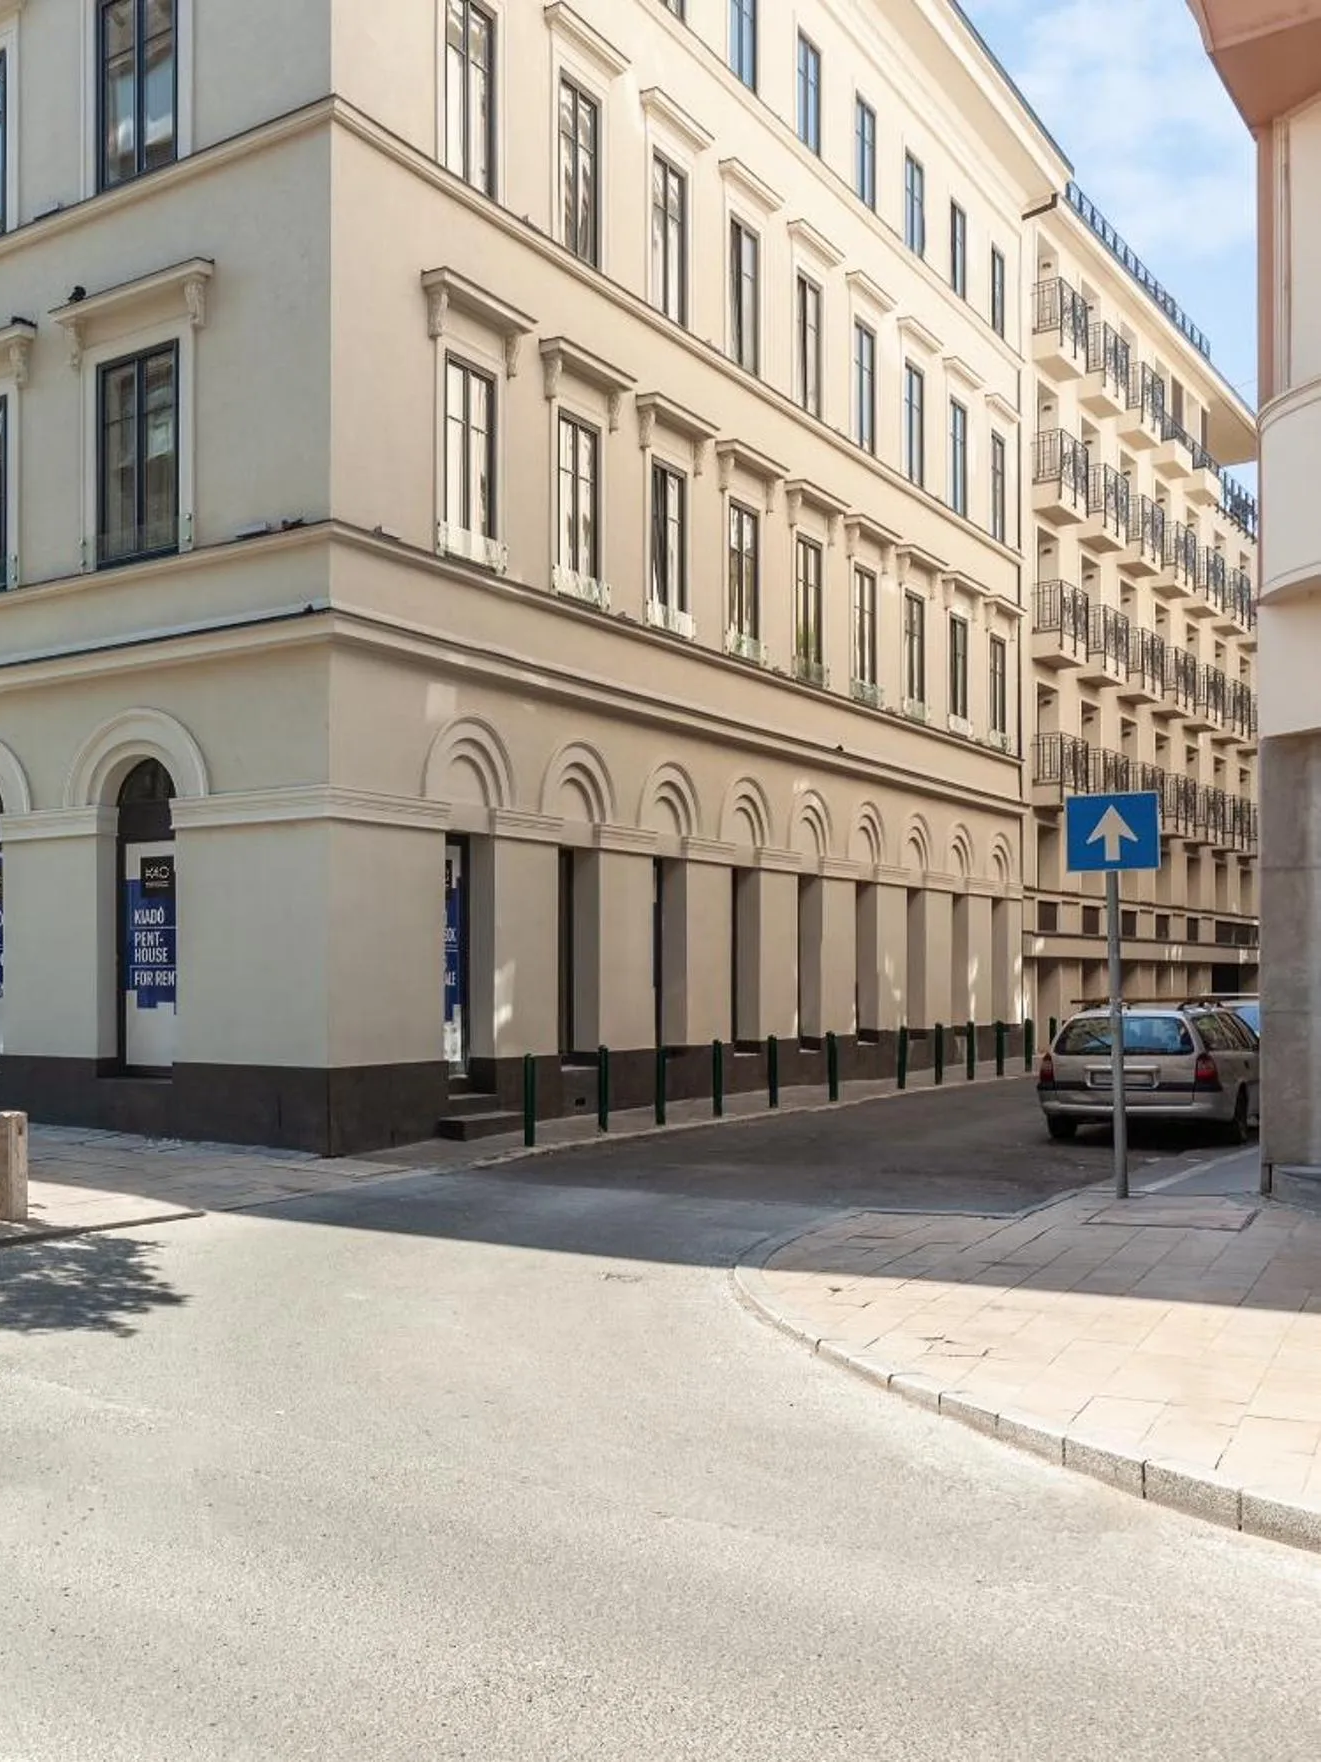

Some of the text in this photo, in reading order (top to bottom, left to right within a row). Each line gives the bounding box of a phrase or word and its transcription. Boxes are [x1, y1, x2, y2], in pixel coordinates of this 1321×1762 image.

[134, 906, 165, 924] KIADÓ
[134, 931, 164, 947] PENT-
[134, 947, 168, 963] HOUSE
[134, 970, 176, 987] FOR REN
